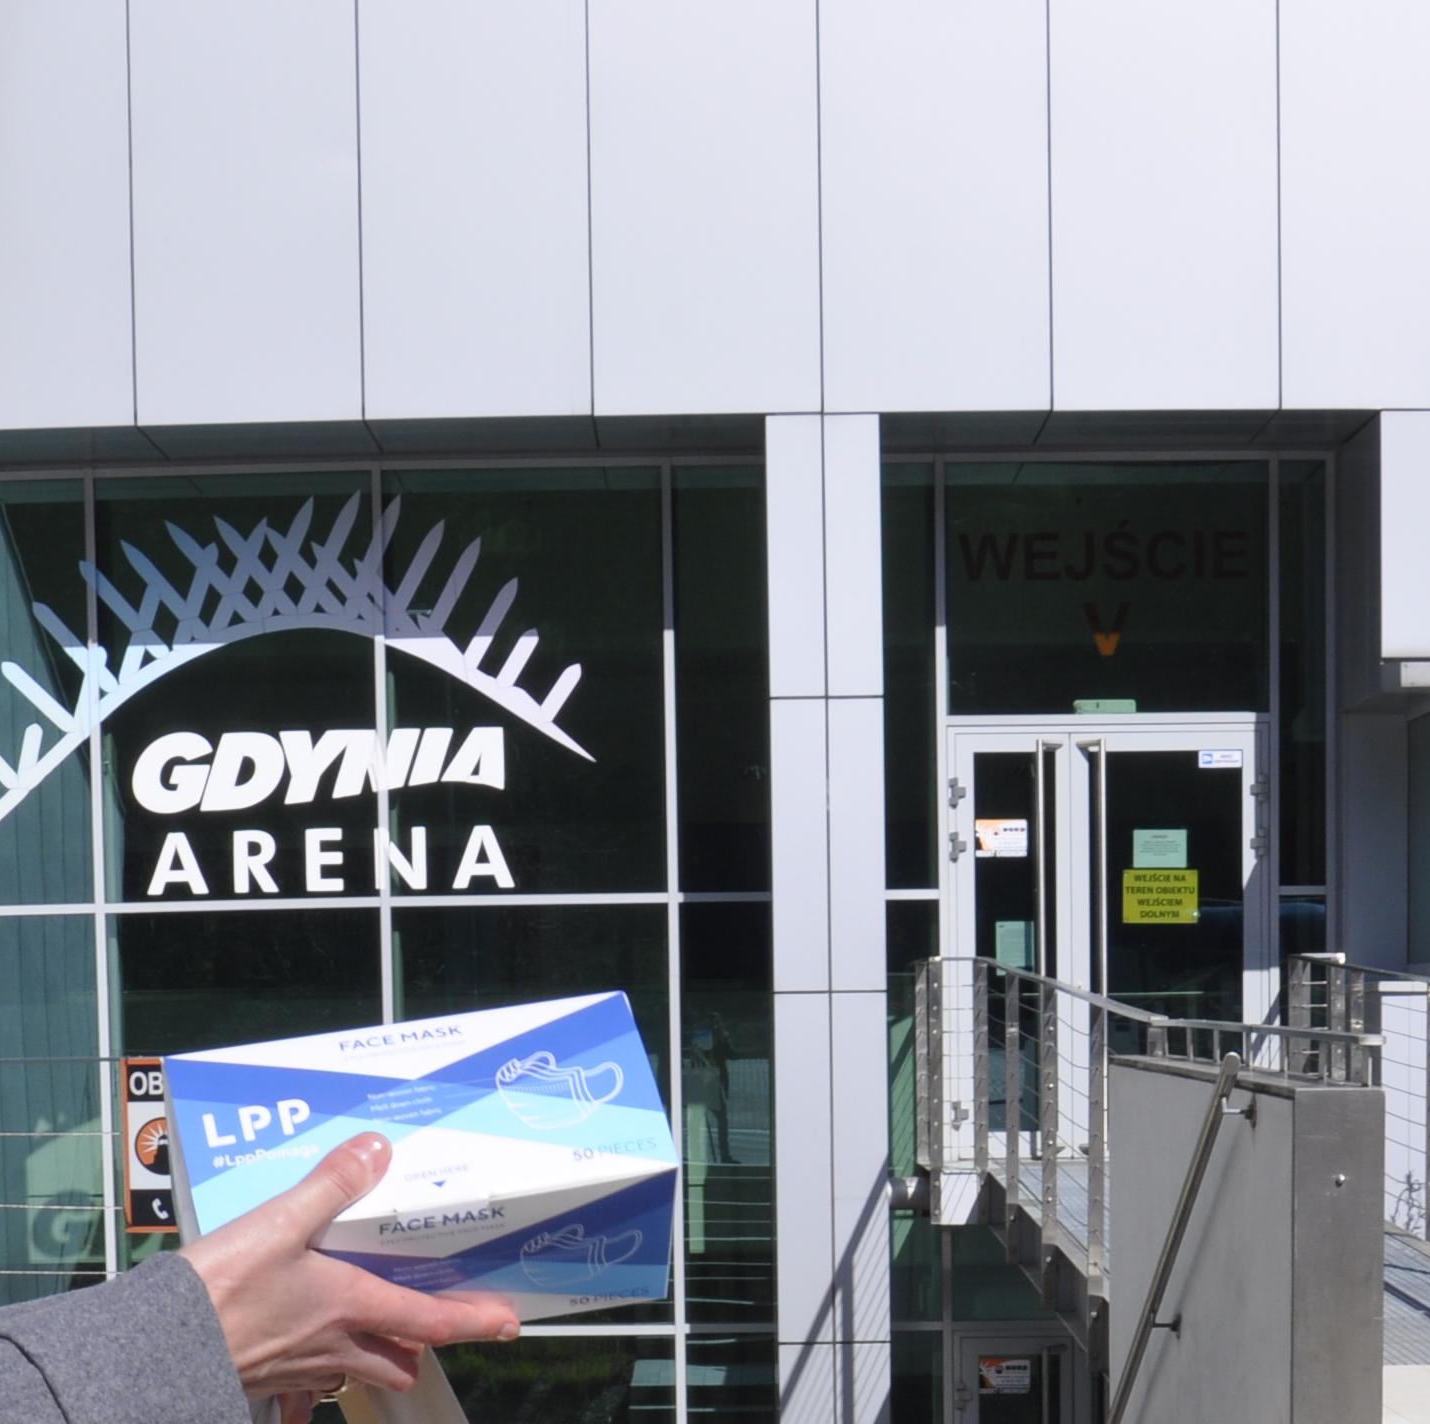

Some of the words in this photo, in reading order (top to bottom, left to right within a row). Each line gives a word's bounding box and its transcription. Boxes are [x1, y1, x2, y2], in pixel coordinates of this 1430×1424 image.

[958, 519, 1250, 581] WEJŚCIE
[132, 727, 505, 814] GDYNIA
[147, 825, 515, 895] ARENA
[1134, 873, 1171, 882] WEJŚCIE
[1174, 874, 1187, 882] NA
[1125, 886, 1153, 894] TEREN
[1156, 886, 1195, 894] OBIEKTU
[1137, 898, 1183, 906] WEJŚCIEM
[1140, 910, 1179, 918] DOLNYM
[339, 1035, 395, 1051] FACE
[401, 1025, 463, 1043] MASK
[202, 1098, 311, 1148] LPP
[213, 1144, 320, 1168] #LppPomaga
[573, 1148, 594, 1162] 50
[598, 1137, 657, 1155] PIECES
[404, 1170, 437, 1182] OPEN
[439, 1163, 470, 1176] HERE
[378, 1216, 437, 1236] FACE
[442, 1206, 505, 1226] MASK
[569, 1296, 590, 1306] 50
[593, 1285, 649, 1303] PIECES
